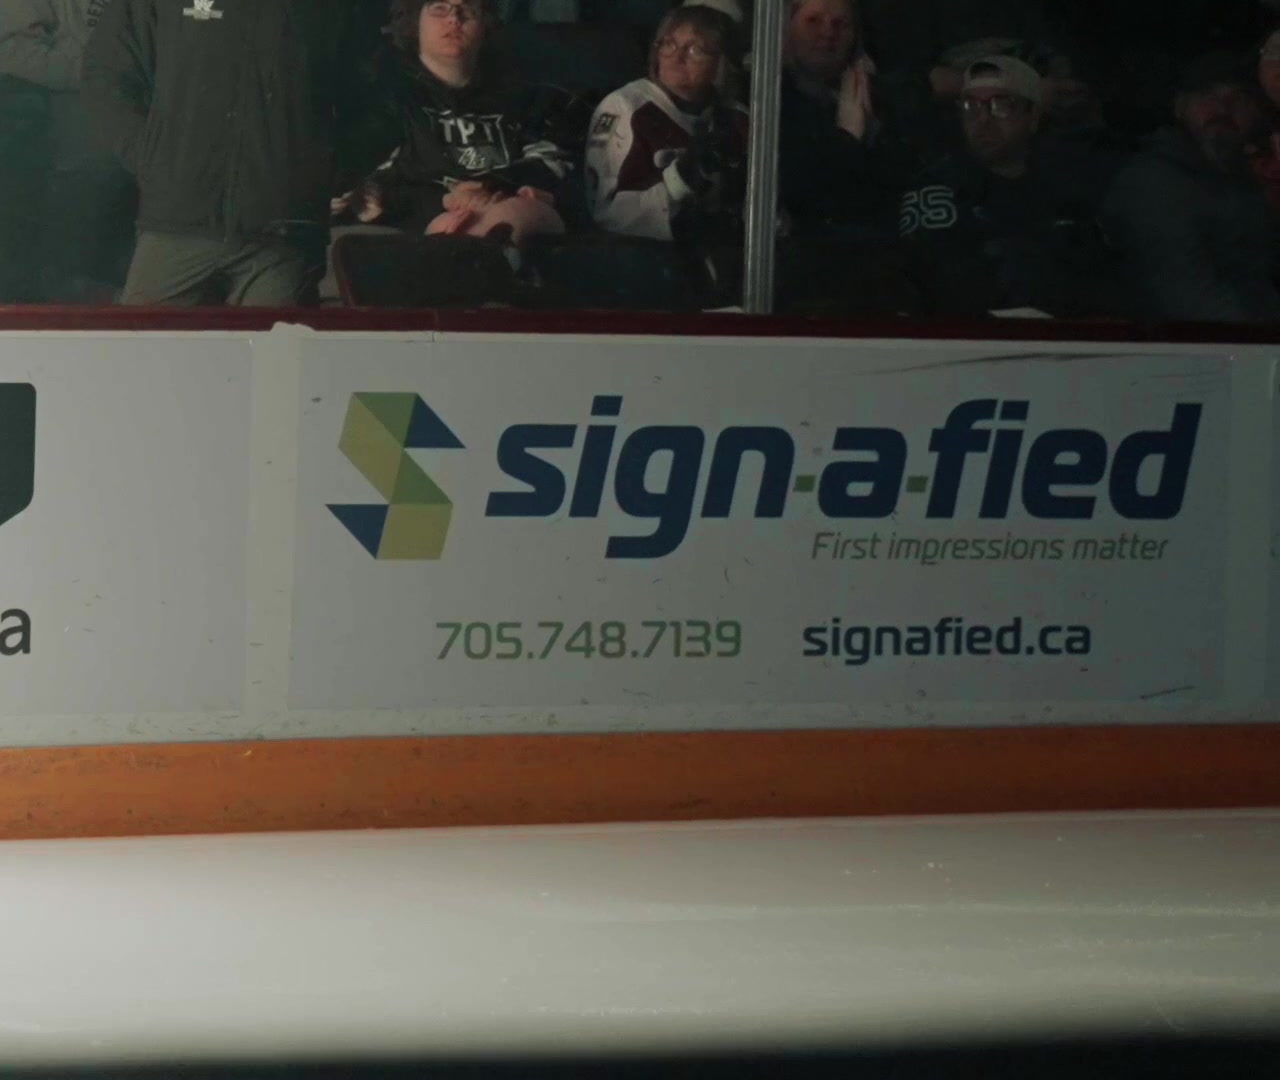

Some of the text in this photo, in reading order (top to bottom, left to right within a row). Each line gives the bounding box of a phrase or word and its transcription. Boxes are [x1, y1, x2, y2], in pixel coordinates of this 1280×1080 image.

[811, 532, 1169, 566] First impressions matter
[437, 617, 1092, 667] 705.748.7139 signafied.ca
